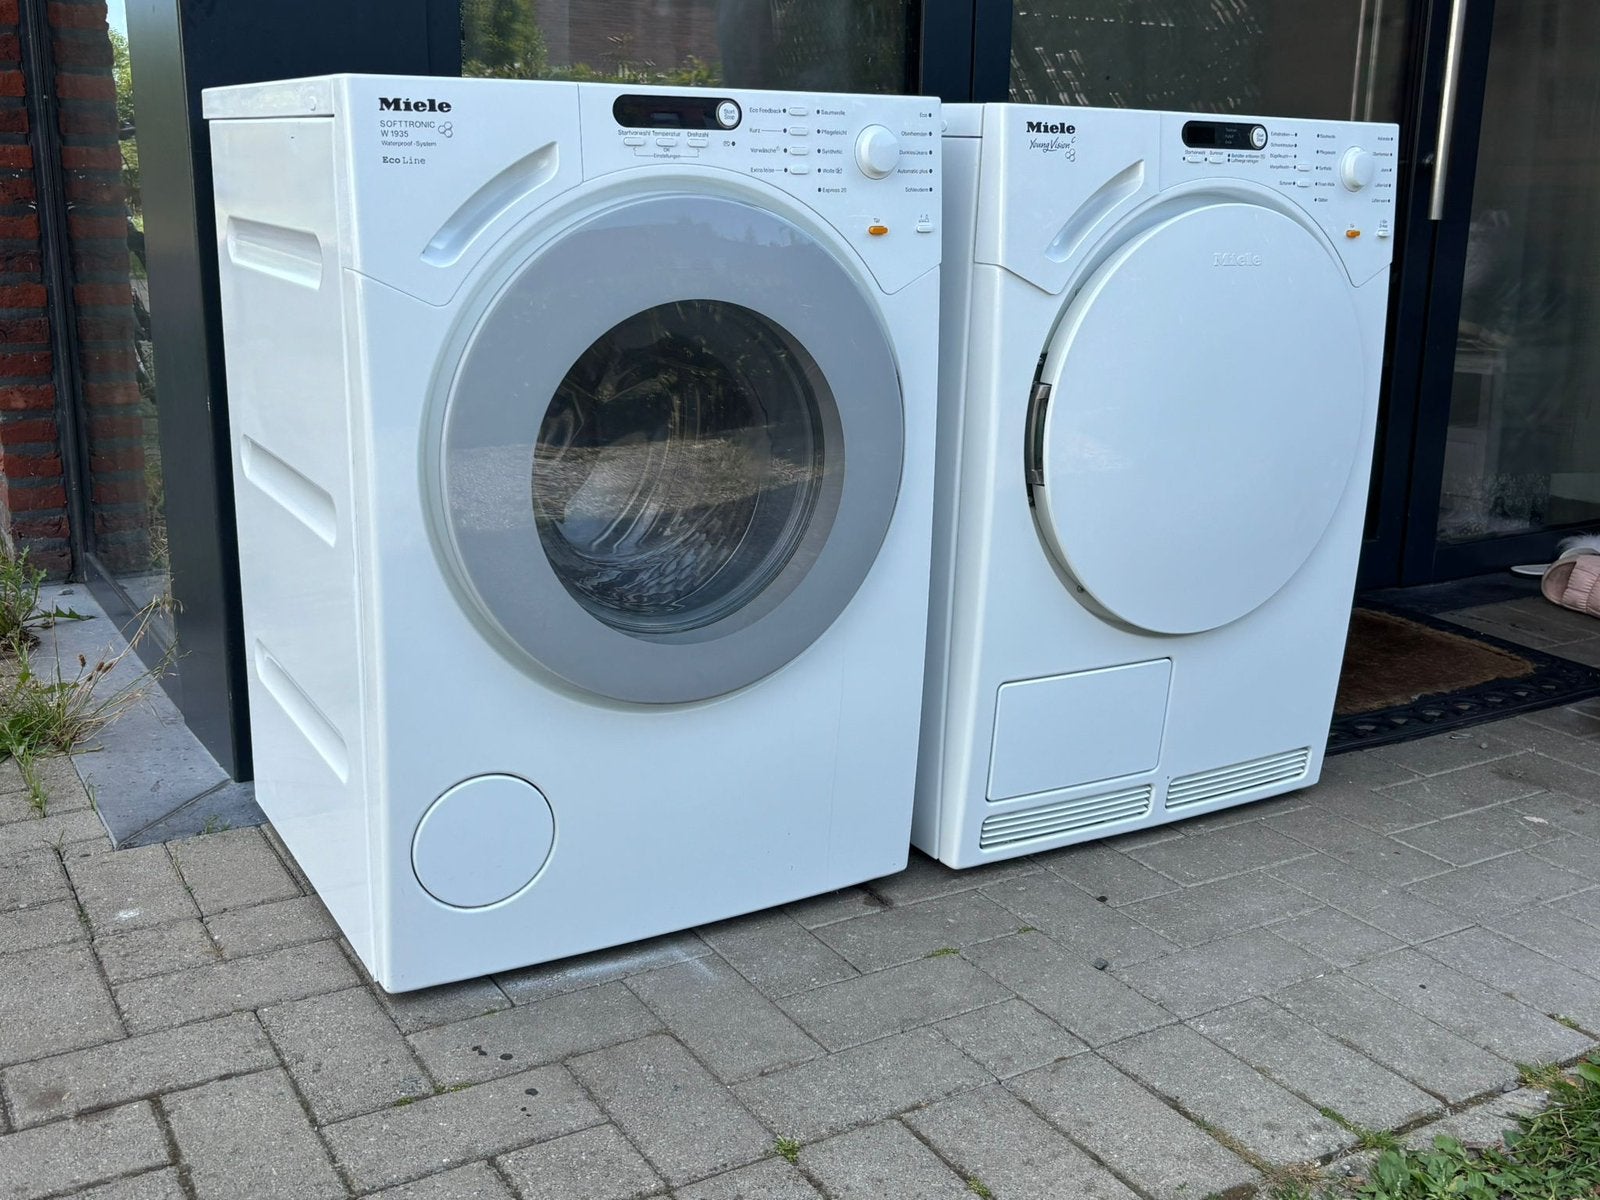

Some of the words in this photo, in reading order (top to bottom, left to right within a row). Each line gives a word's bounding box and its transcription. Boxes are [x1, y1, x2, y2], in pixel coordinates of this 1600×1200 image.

[379, 97, 452, 113] Miele
[380, 120, 436, 129] SOFTTRONIC
[1026, 121, 1076, 134] Miele
[381, 130, 389, 138] W
[391, 130, 409, 138] 1935
[1213, 252, 1262, 267] Miele
